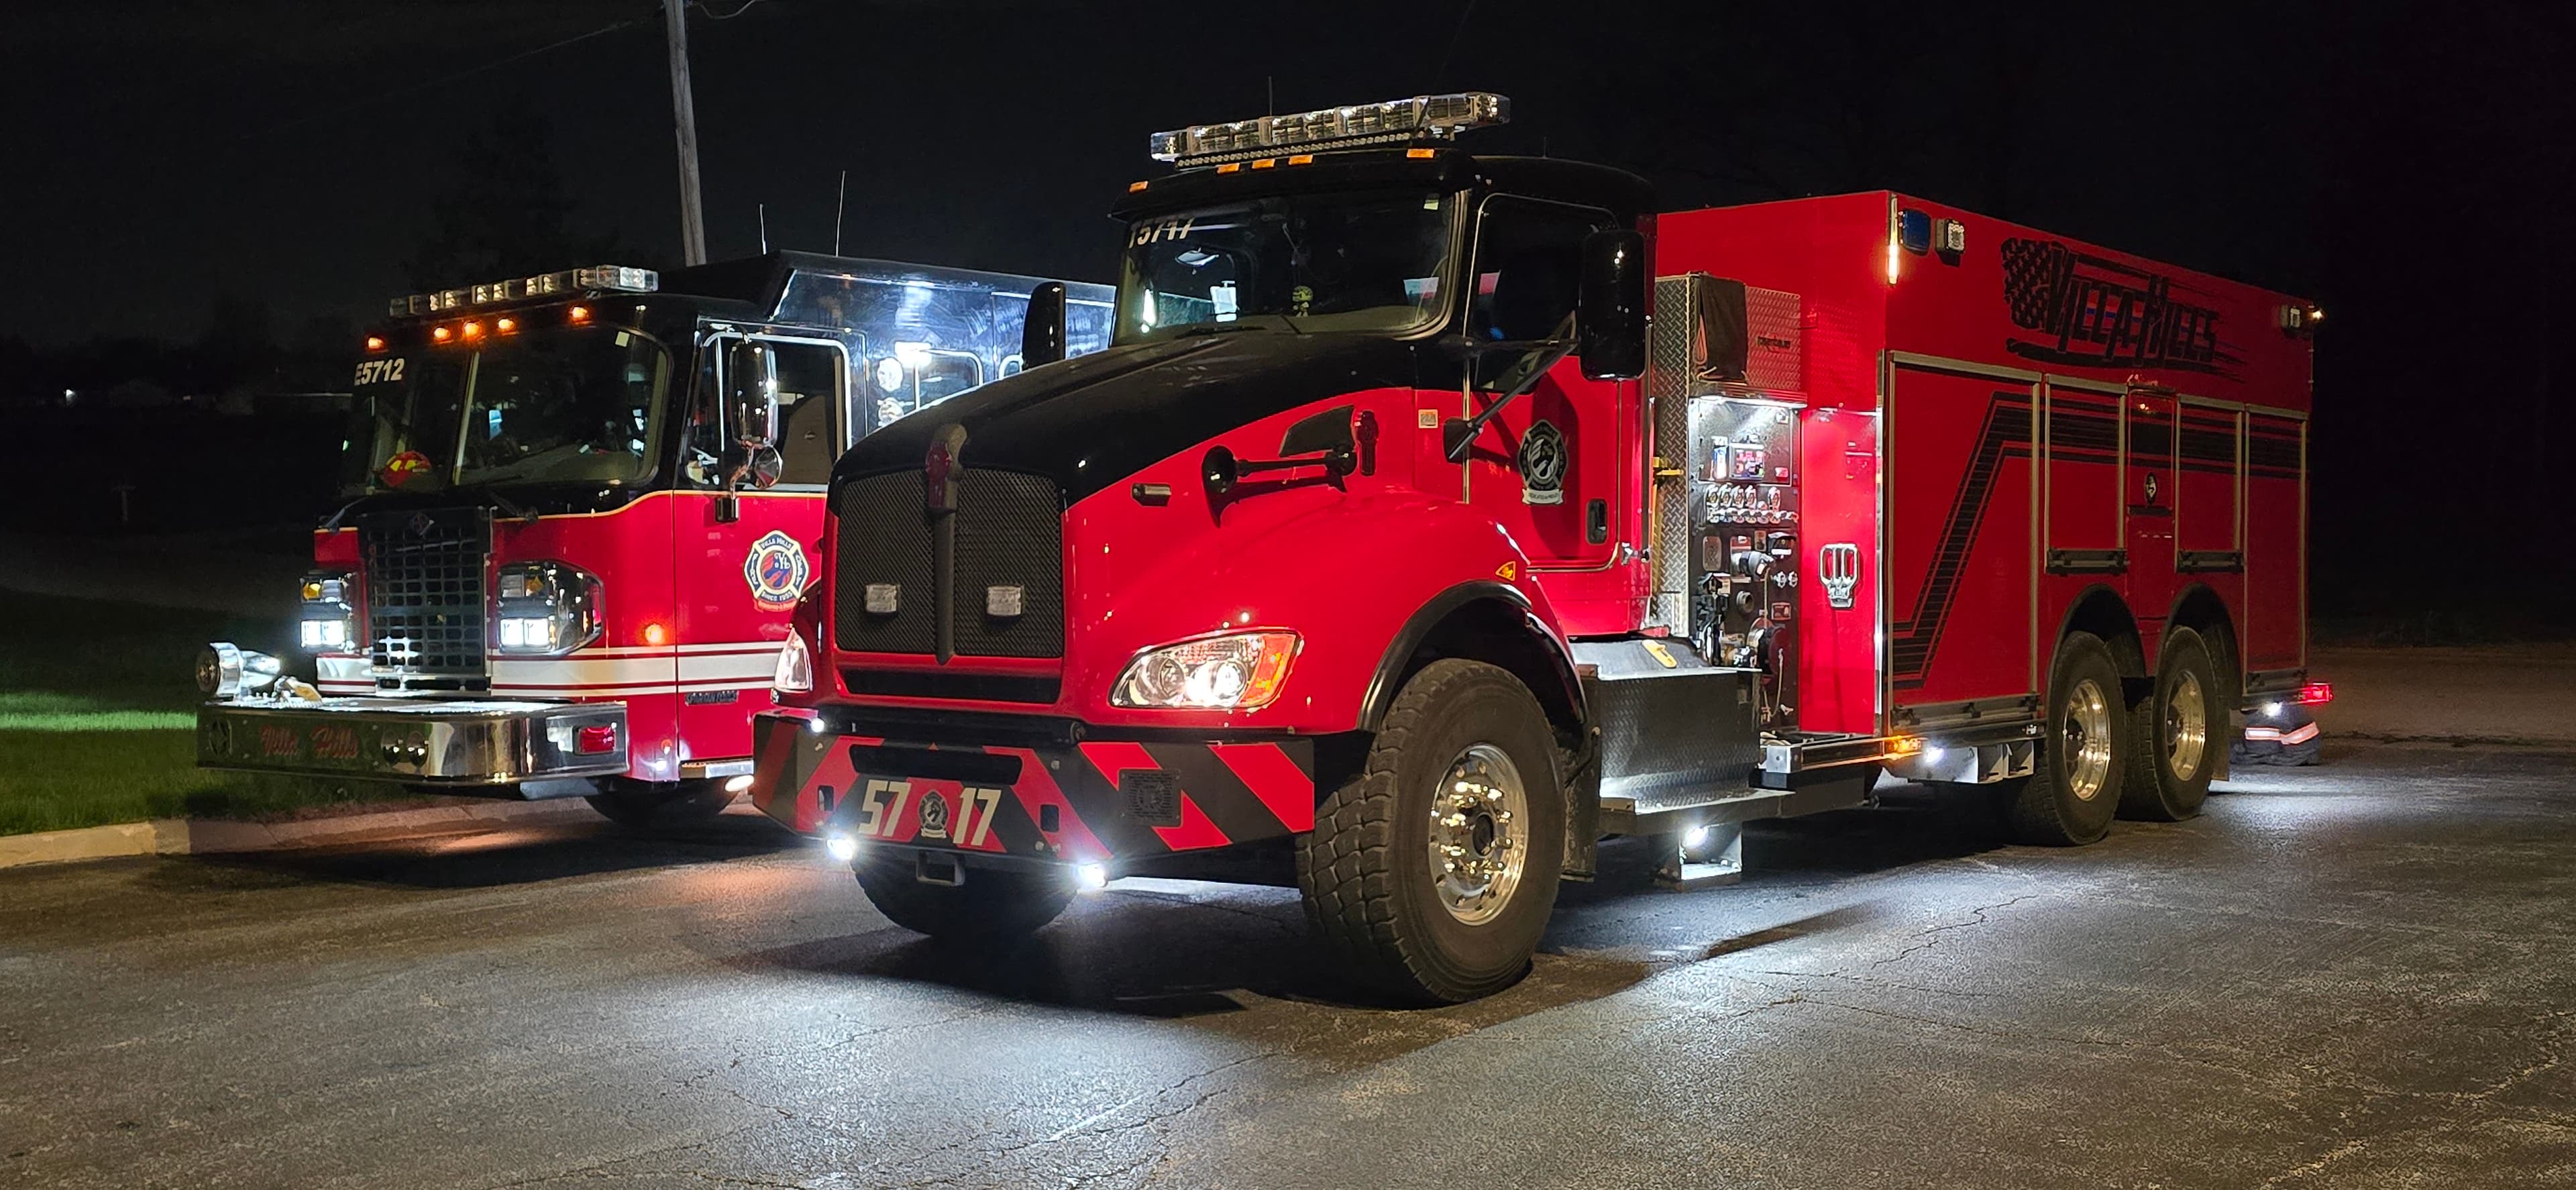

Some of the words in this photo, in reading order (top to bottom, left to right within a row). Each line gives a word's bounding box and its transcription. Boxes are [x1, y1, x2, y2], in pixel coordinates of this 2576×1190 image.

[354, 358, 405, 386] E5712
[858, 779, 912, 838] 57
[952, 787, 1002, 847] 17
